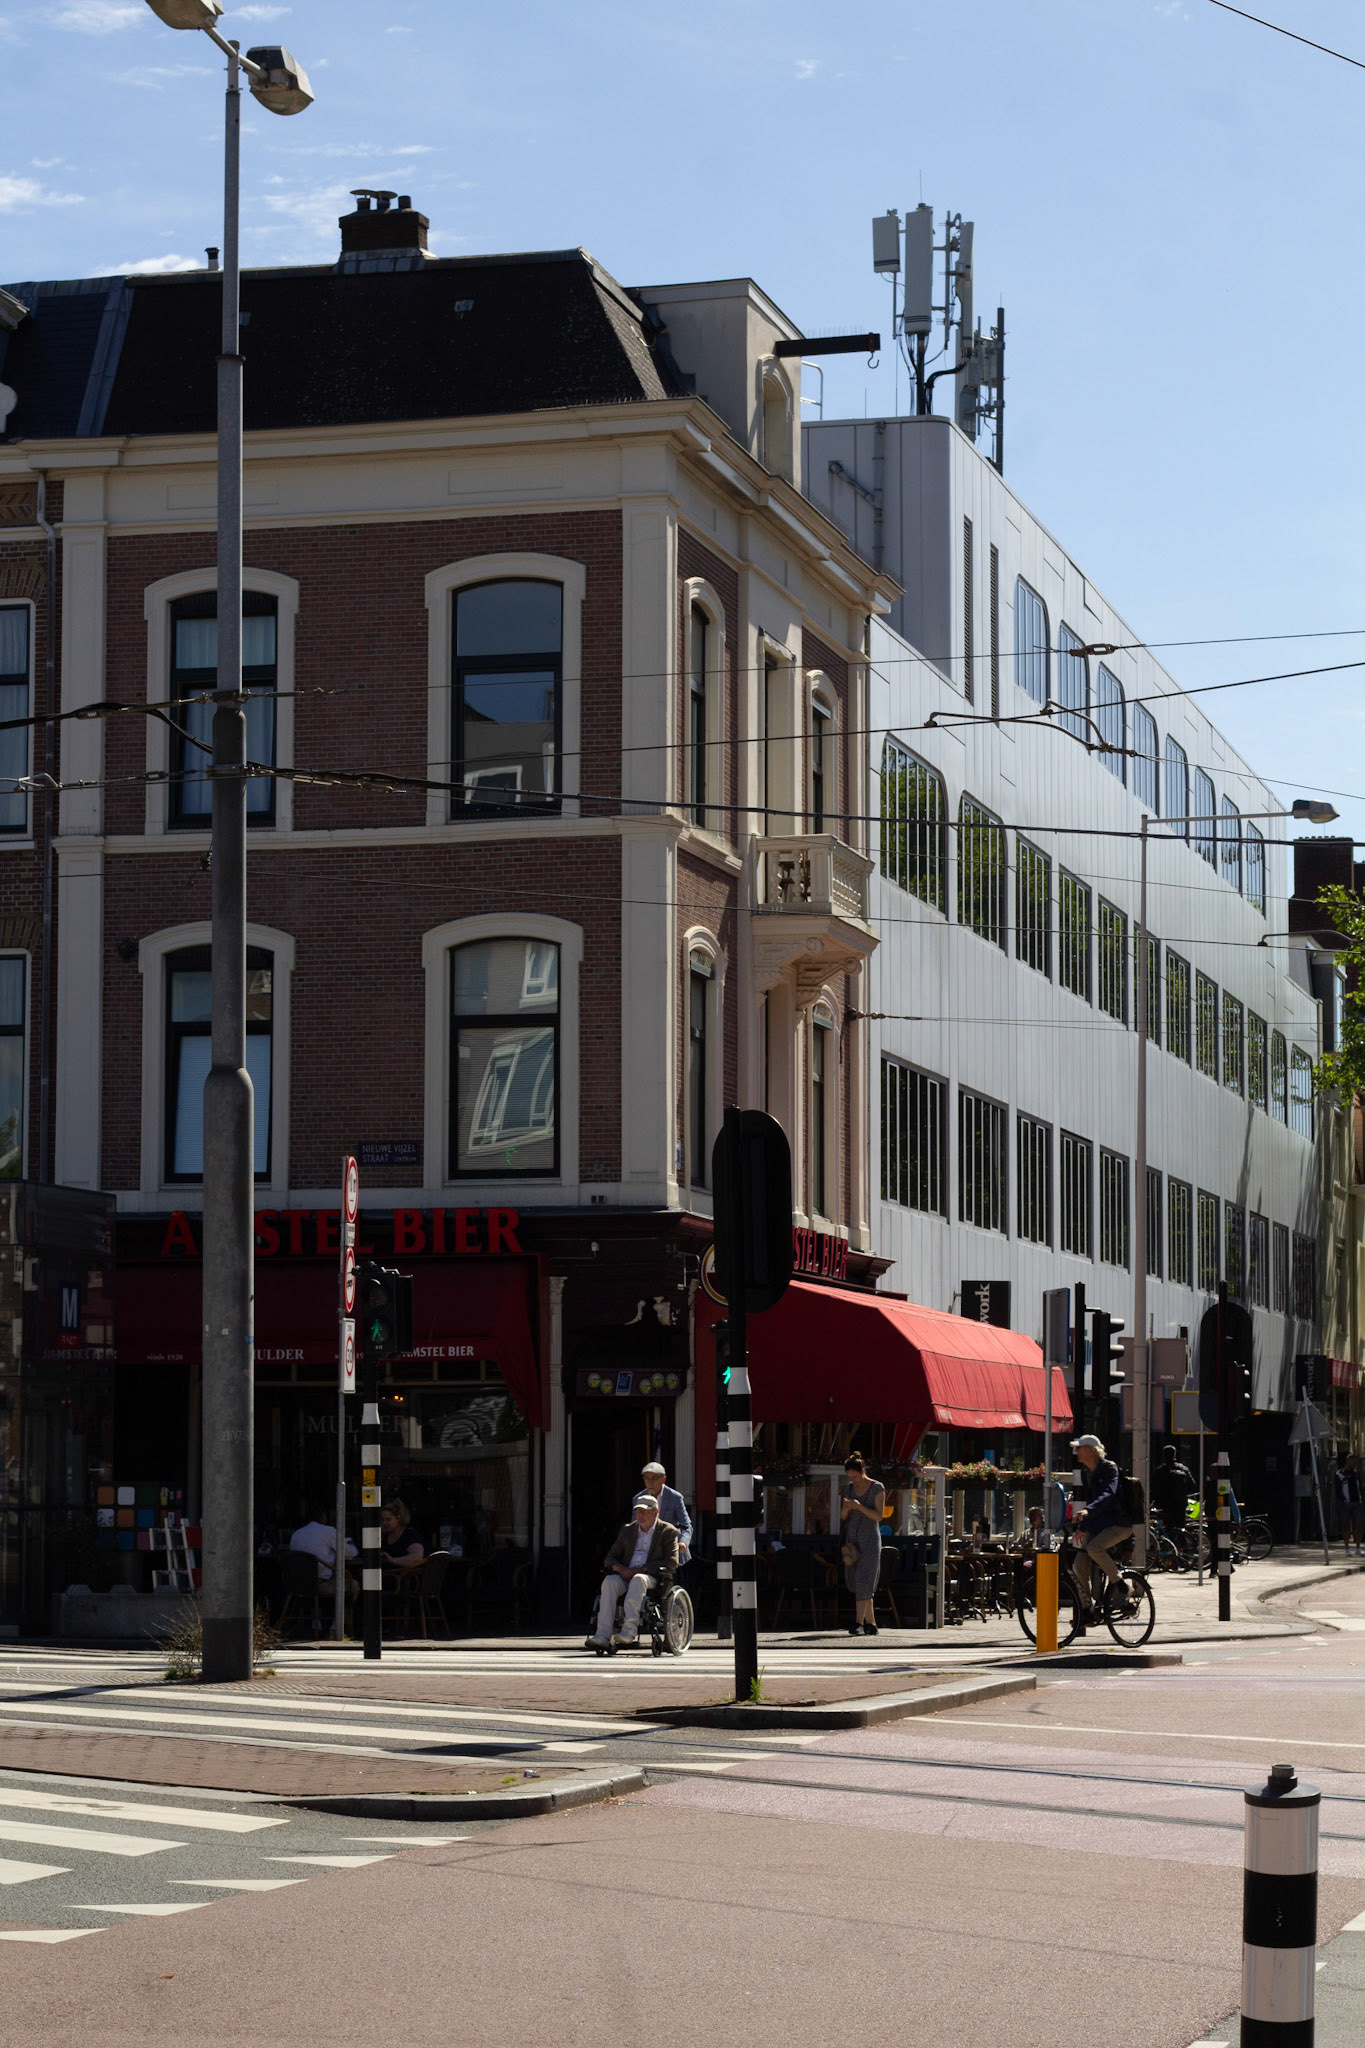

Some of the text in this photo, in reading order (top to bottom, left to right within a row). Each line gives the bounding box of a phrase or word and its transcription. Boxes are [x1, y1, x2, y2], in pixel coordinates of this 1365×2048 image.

[362, 1143, 416, 1154] NIEUWE VIJZEL
[362, 1154, 389, 1163] STRAAT
[160, 1208, 375, 1257] ASTEL
[393, 1207, 524, 1255] BIER
[792, 1226, 848, 1281] STEL BIER
[62, 1287, 78, 1328] M
[146, 1353, 183, 1361] sinds 1920
[254, 1348, 304, 1361] ULDER
[448, 1345, 475, 1357] BIER
[307, 1415, 405, 1433] MULER
